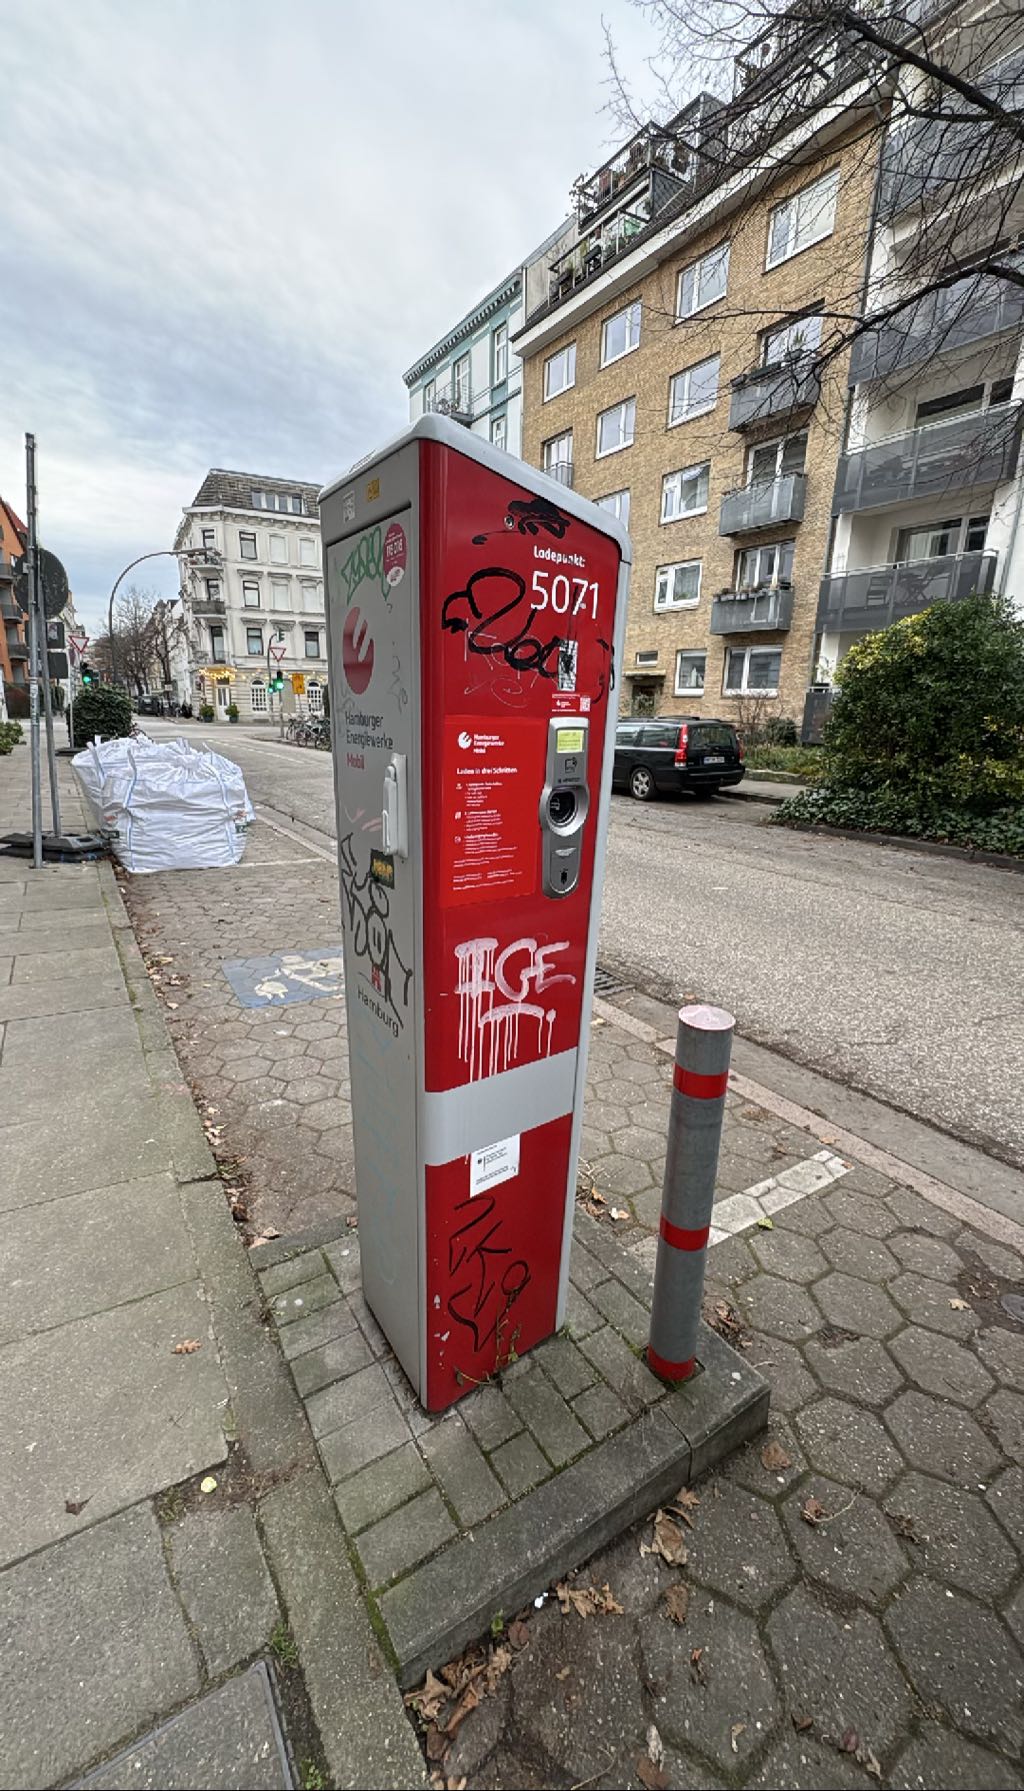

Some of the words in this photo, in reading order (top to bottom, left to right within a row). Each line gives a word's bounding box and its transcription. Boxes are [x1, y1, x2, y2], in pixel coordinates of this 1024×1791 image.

[530, 570, 599, 619] 5071
[345, 711, 383, 730] Hamburger
[346, 729, 393, 750] Energiewerke
[346, 752, 365, 770] Mobil
[356, 985, 400, 1037] Hamburg
